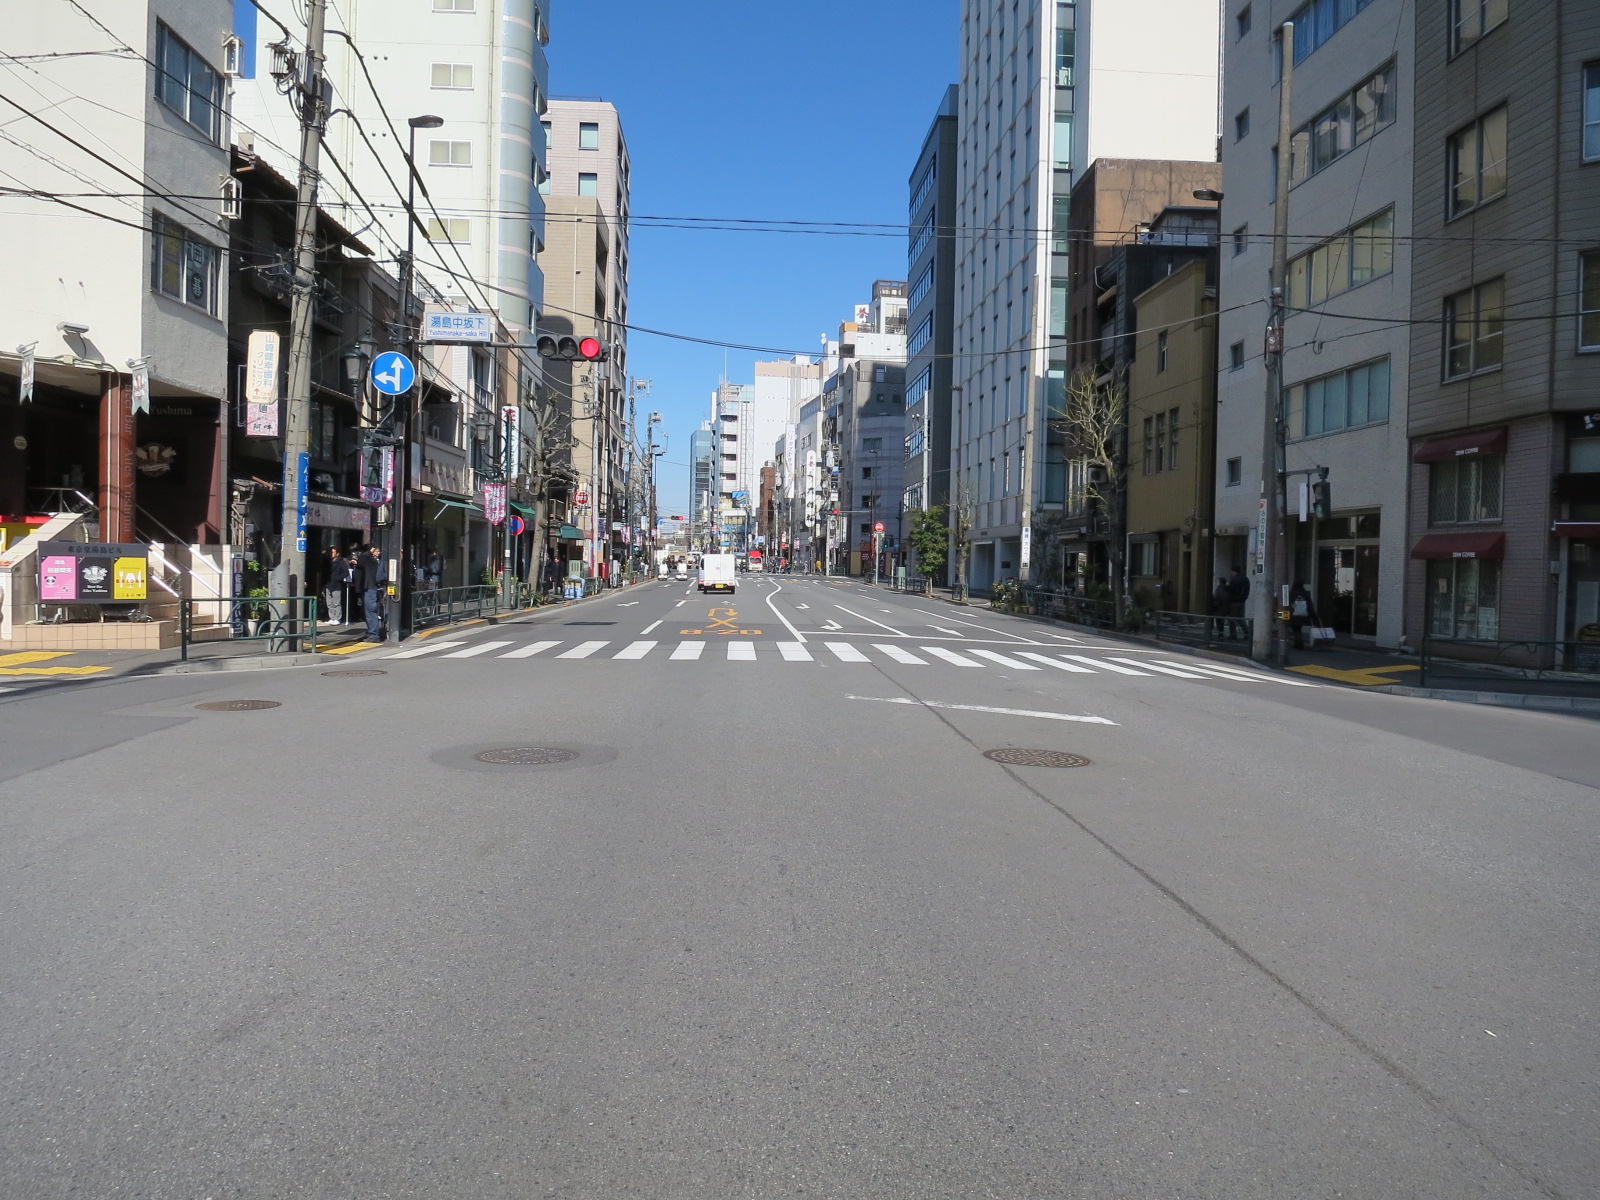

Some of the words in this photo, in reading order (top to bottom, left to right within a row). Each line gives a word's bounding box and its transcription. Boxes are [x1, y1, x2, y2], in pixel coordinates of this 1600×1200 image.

[431, 316, 485, 329] 湯島中坂下
[428, 329, 477, 337] Yushimanaka-saka
[150, 405, 192, 416] Yushima
[124, 414, 134, 433] Bar
[124, 448, 134, 478] Ailes
[124, 483, 135, 532] Yushima
